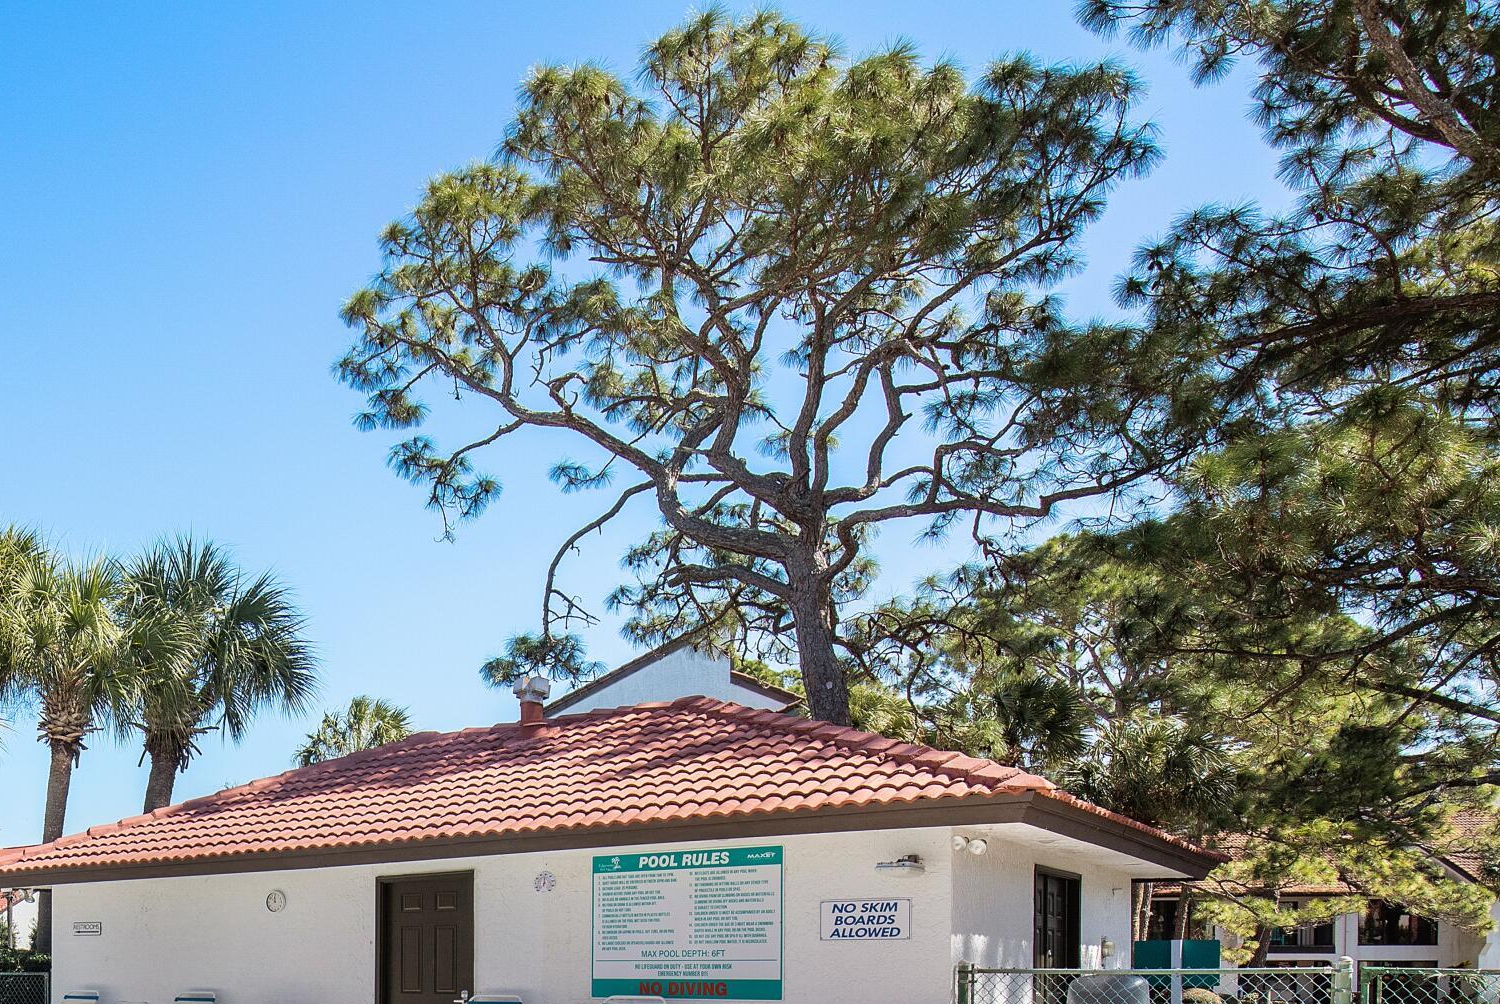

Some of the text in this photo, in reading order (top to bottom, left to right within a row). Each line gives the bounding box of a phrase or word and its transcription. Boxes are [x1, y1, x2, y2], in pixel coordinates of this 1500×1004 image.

[639, 852, 730, 868] POOL RULES
[832, 902, 898, 913] NO SKIM
[834, 915, 895, 925] BOARDS
[830, 927, 901, 938] ALLOWED
[711, 949, 726, 957] 6FT
[639, 981, 727, 996] NO DIVING
